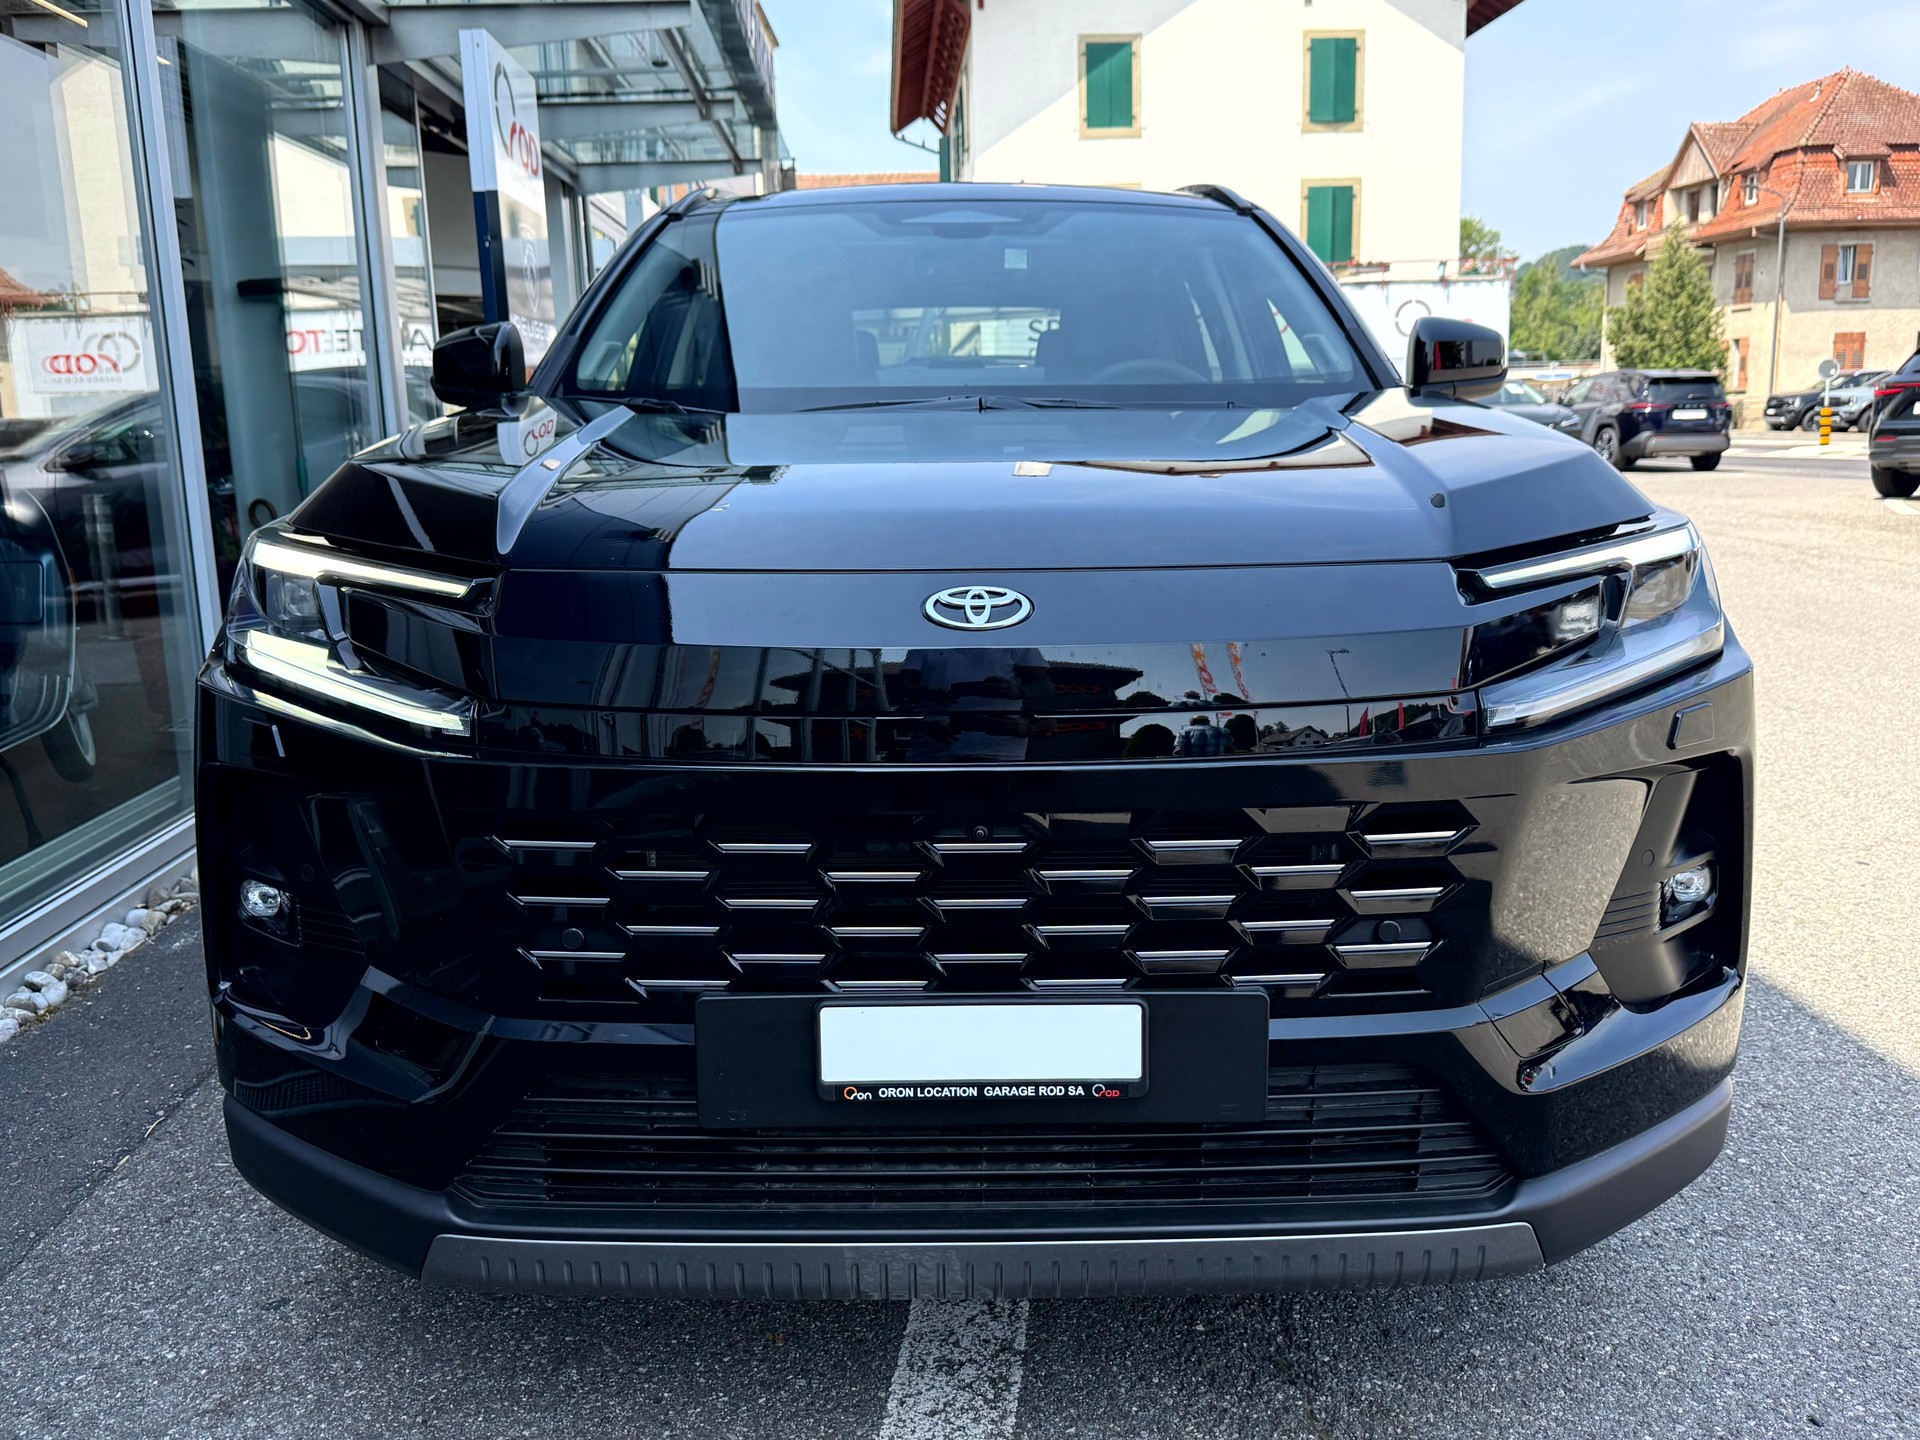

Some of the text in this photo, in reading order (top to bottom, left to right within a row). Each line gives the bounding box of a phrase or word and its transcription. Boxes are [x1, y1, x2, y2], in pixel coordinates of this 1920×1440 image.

[878, 1087, 914, 1098] ORON
[917, 1087, 977, 1097] LOCATION
[984, 1086, 1035, 1097] GARAGE
[1039, 1086, 1065, 1096] ROD
[1068, 1086, 1085, 1095] SA
